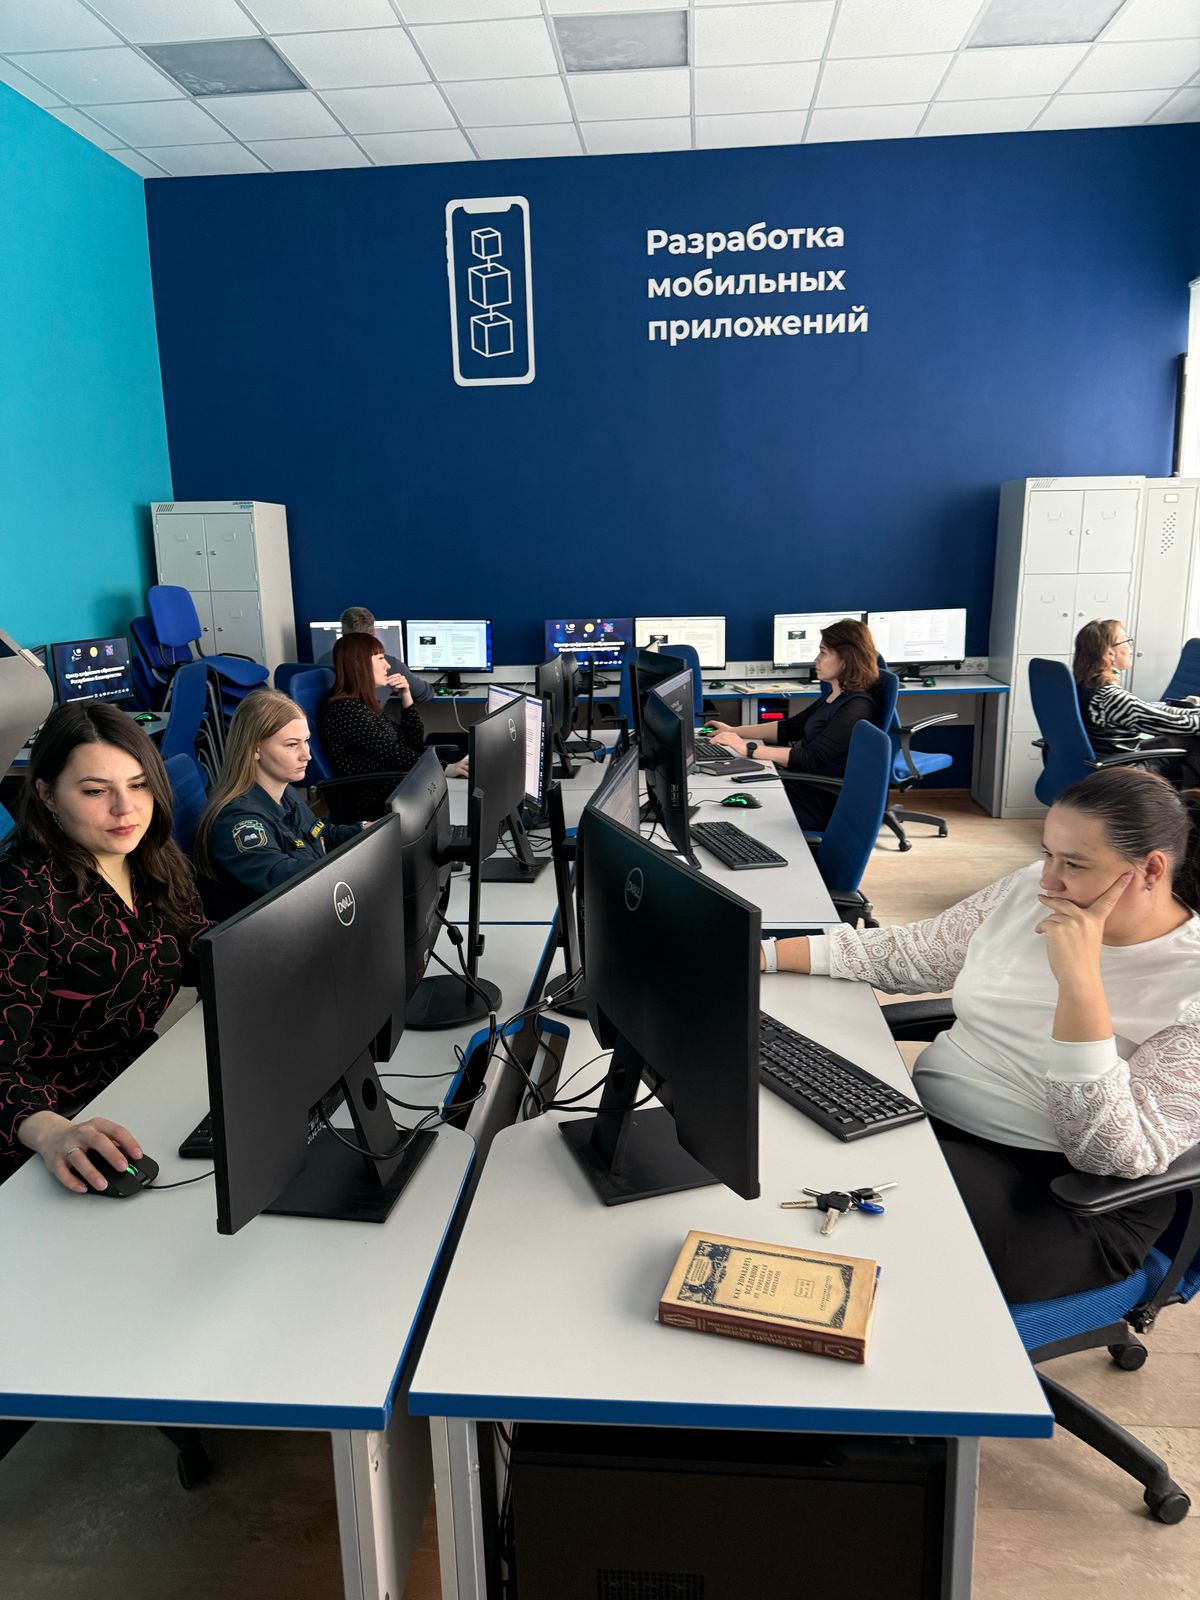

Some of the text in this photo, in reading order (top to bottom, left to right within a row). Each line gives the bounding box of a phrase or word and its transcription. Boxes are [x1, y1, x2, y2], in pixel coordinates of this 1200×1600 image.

[647, 222, 845, 259] Разработка
[647, 268, 846, 298] мобильных
[648, 305, 869, 347] приложений
[337, 894, 353, 914] DELL
